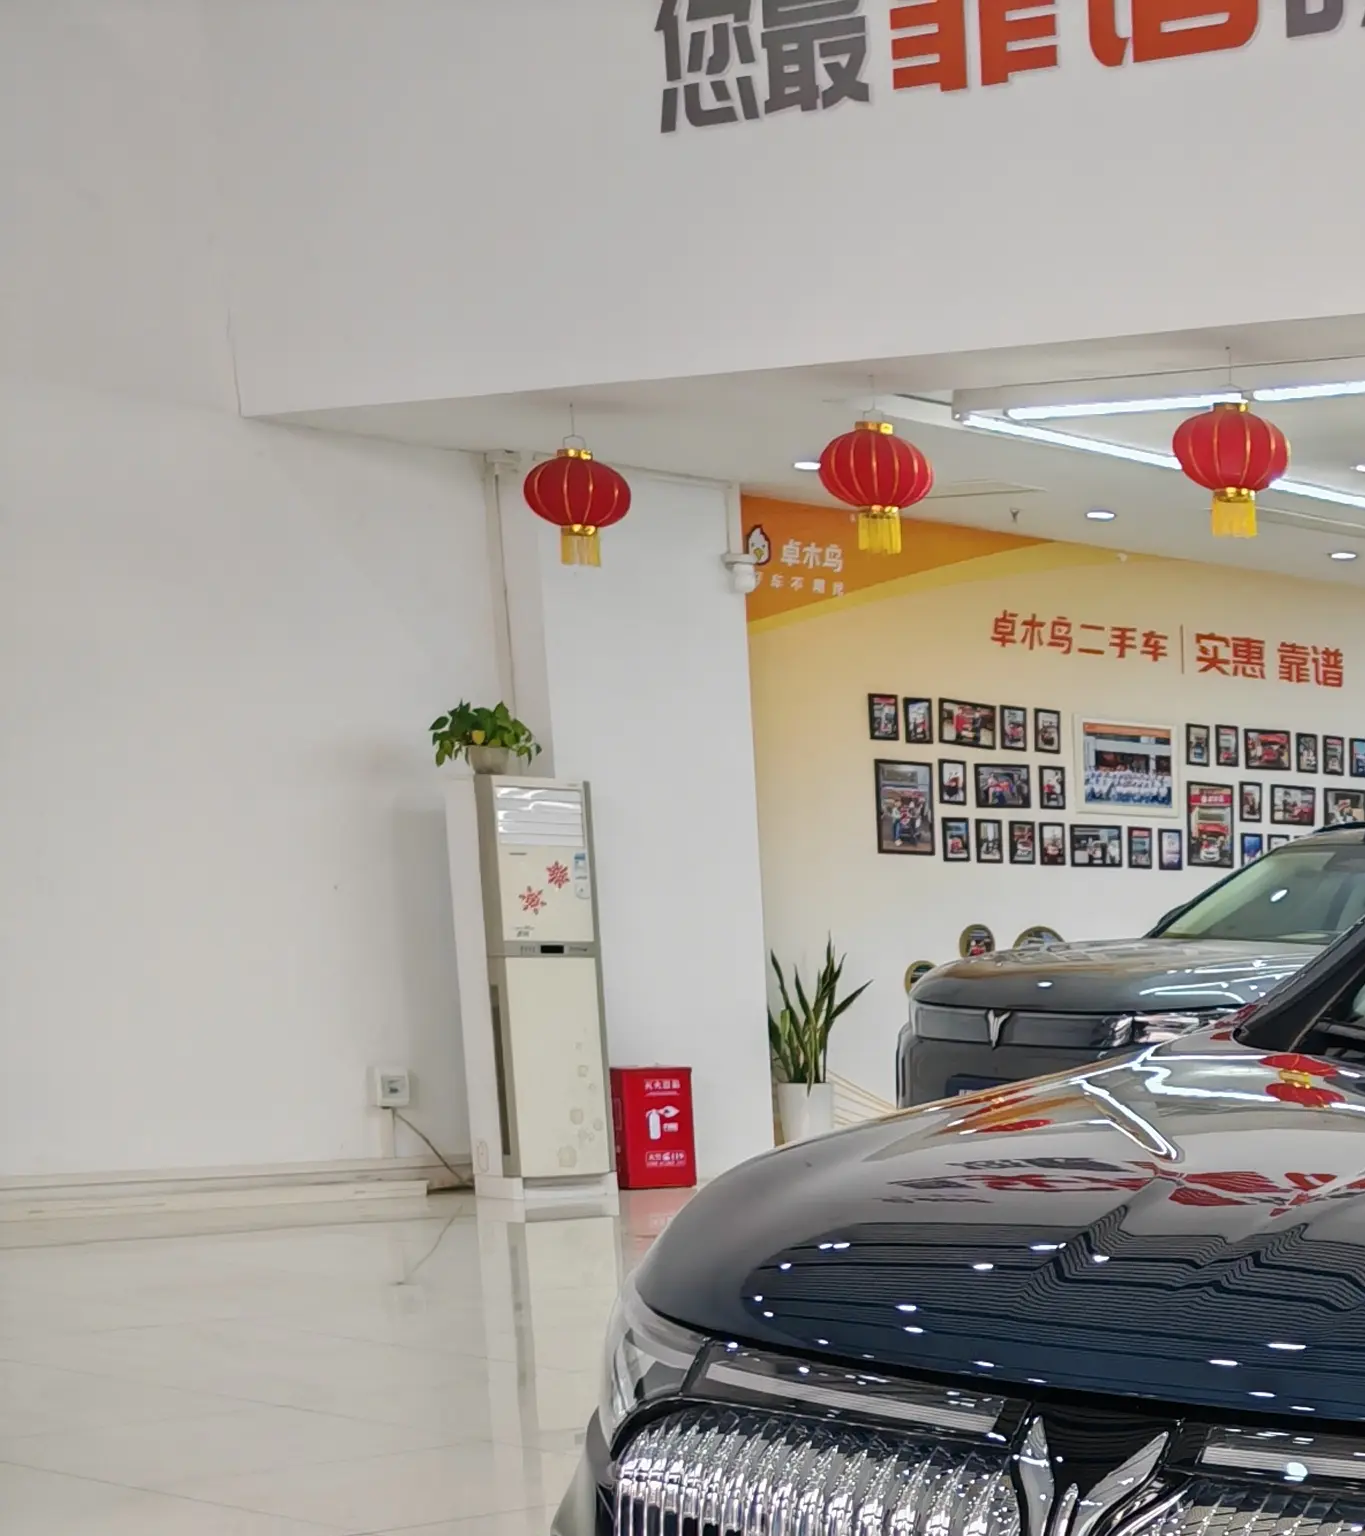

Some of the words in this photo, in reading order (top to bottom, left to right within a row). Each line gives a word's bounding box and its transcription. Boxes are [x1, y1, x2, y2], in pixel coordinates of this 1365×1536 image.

[780, 538, 844, 573] 卓木鸟
[990, 609, 1169, 663] 卓木鸟二手车
[1195, 632, 1266, 680] 实惠
[1277, 641, 1344, 688] 靠谱
